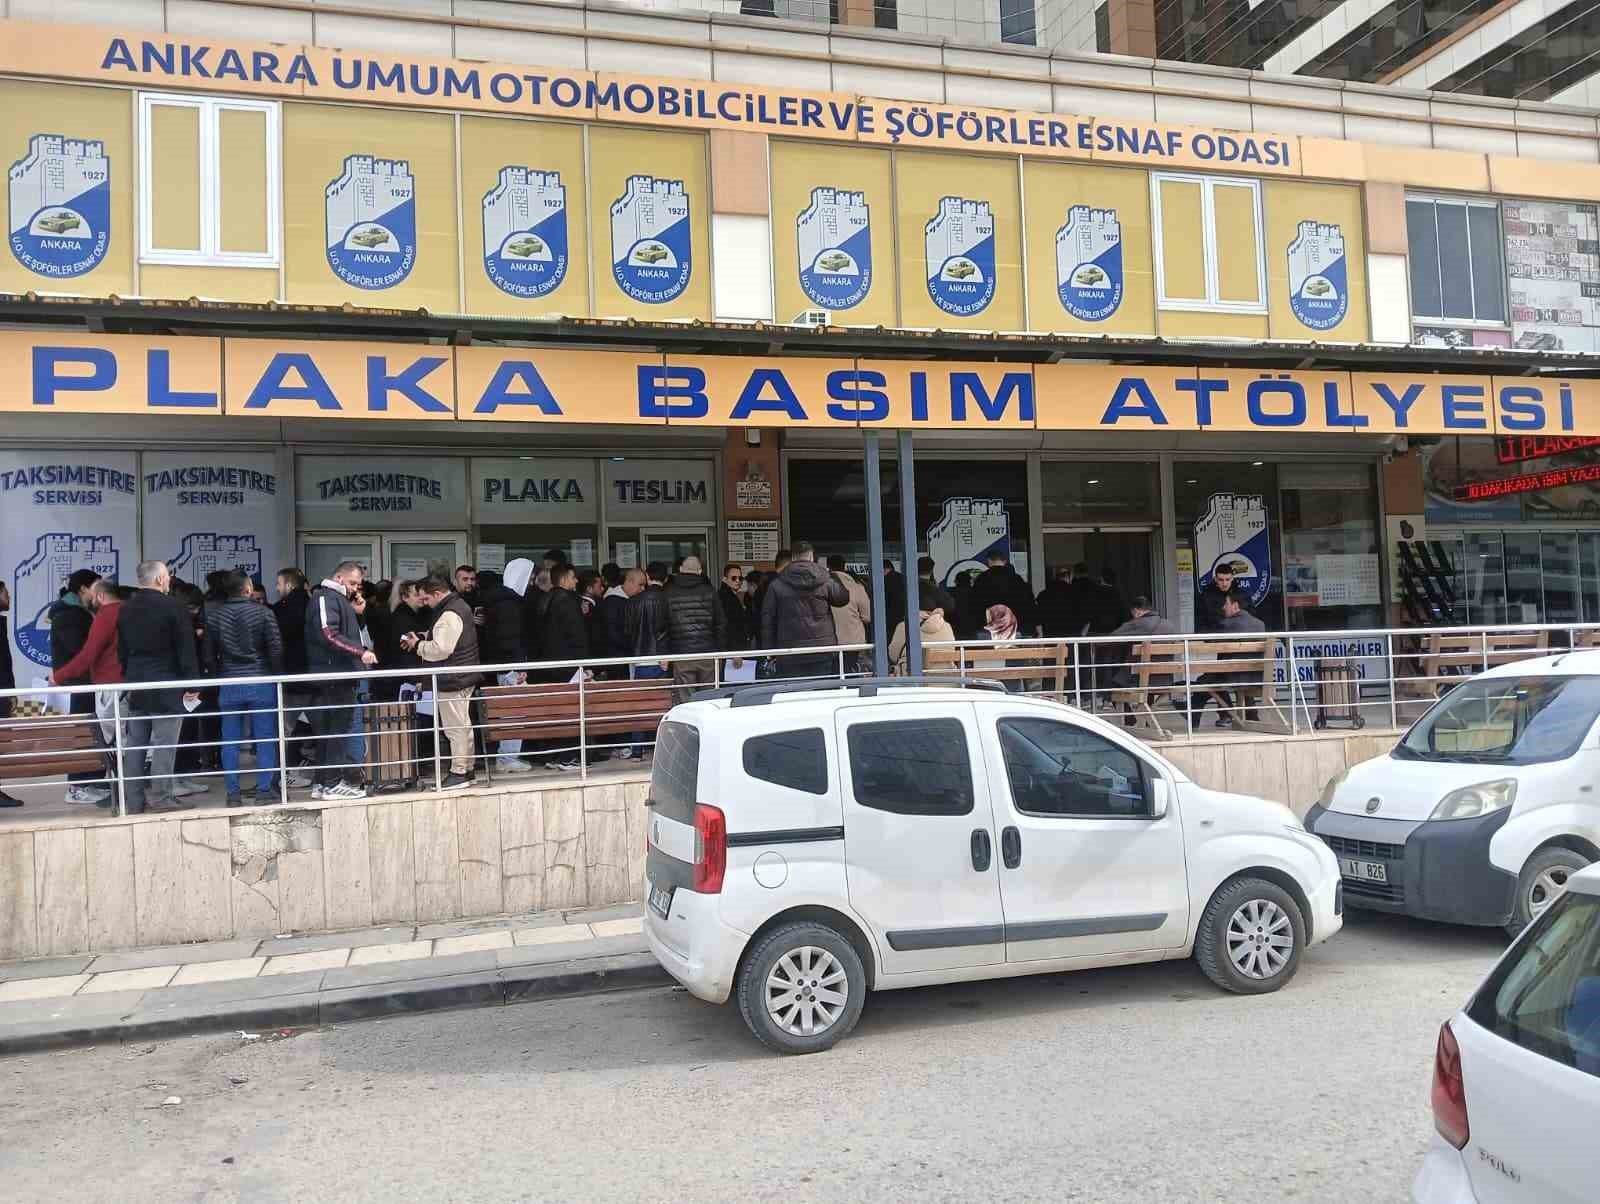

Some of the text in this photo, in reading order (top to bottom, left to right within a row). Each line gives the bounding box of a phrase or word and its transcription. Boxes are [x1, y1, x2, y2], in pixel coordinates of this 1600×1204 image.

[101, 38, 318, 87] ANKARA
[332, 57, 482, 99] UMUM
[829, 102, 875, 133] VE
[885, 107, 1071, 148] ŞÖFÖRLER
[1077, 124, 1184, 157] ESNAF
[1191, 134, 1291, 167] ODASI
[82, 170, 105, 180] 1927
[390, 188, 411, 198] 1927
[544, 199, 562, 208] 1927
[668, 207, 687, 215] 1927
[849, 217, 866, 225] 1927
[976, 225, 991, 234] 1927
[40, 239, 82, 250] ANKARA
[354, 253, 391, 264] ANKARA
[510, 262, 545, 273] ANKARA
[637, 269, 670, 280] ANKARA
[821, 277, 852, 286] ANKARA
[948, 284, 977, 293] ANKARA
[32, 346, 1575, 431] PLAKA BASIM ATÖLYESİ
[484, 478, 584, 503] PLAKA
[1248, 520, 1264, 529] 1927
[987, 527, 1005, 536] 1927
[91, 563, 114, 573] 1927
